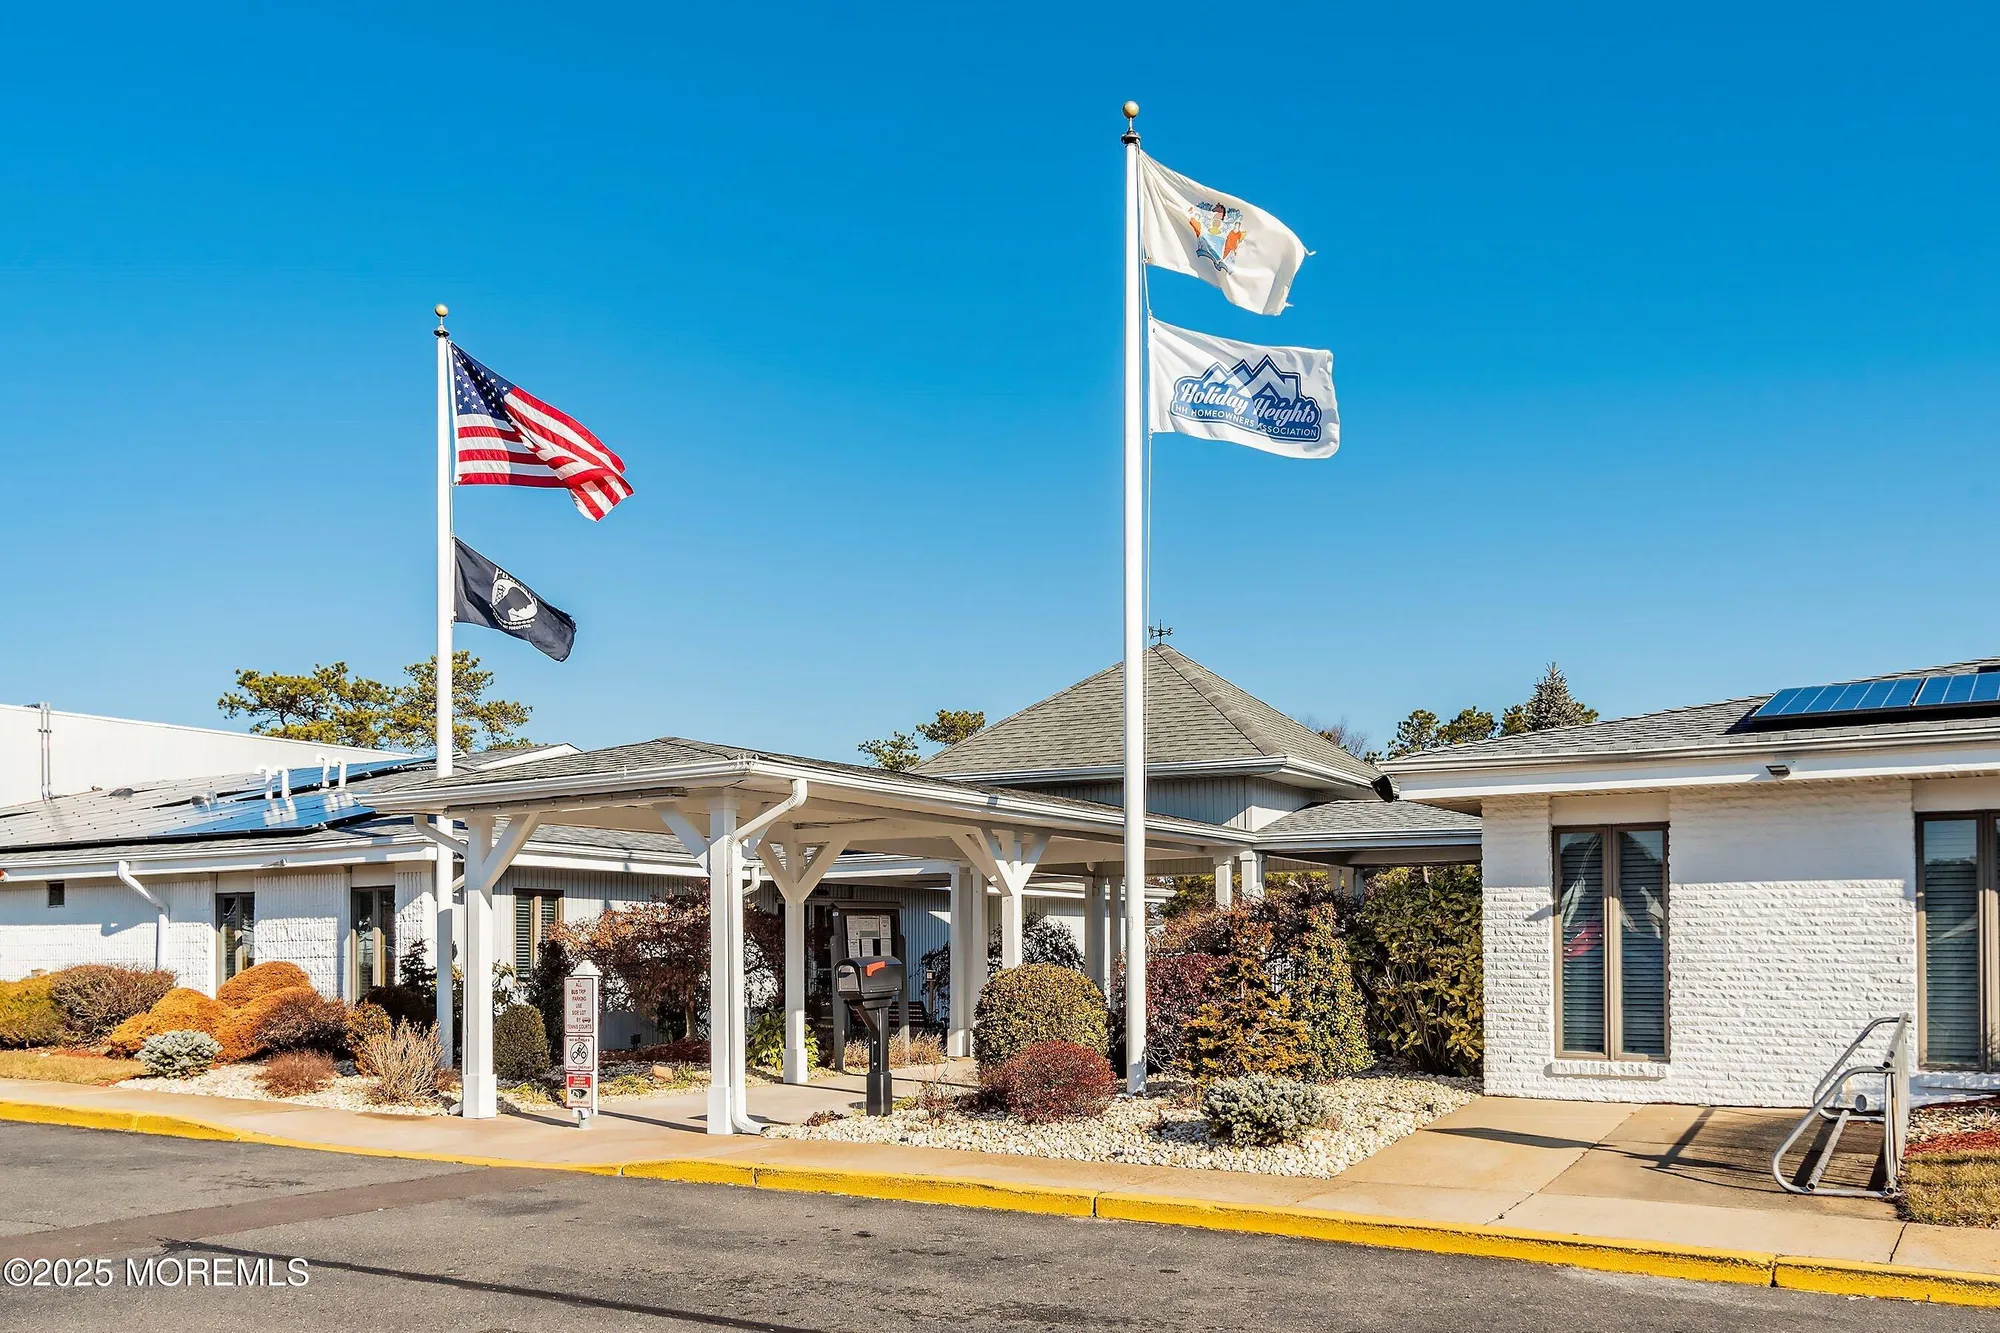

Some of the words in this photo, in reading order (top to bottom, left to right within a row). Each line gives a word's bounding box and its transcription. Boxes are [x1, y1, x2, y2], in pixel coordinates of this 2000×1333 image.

[1174, 404, 1188, 414] HH
[1190, 408, 1255, 427] HOMEOWNERS
[1256, 422, 1317, 437] ASSOCIATION
[1180, 382, 1249, 415] Holiday
[1253, 397, 1316, 427] Heights
